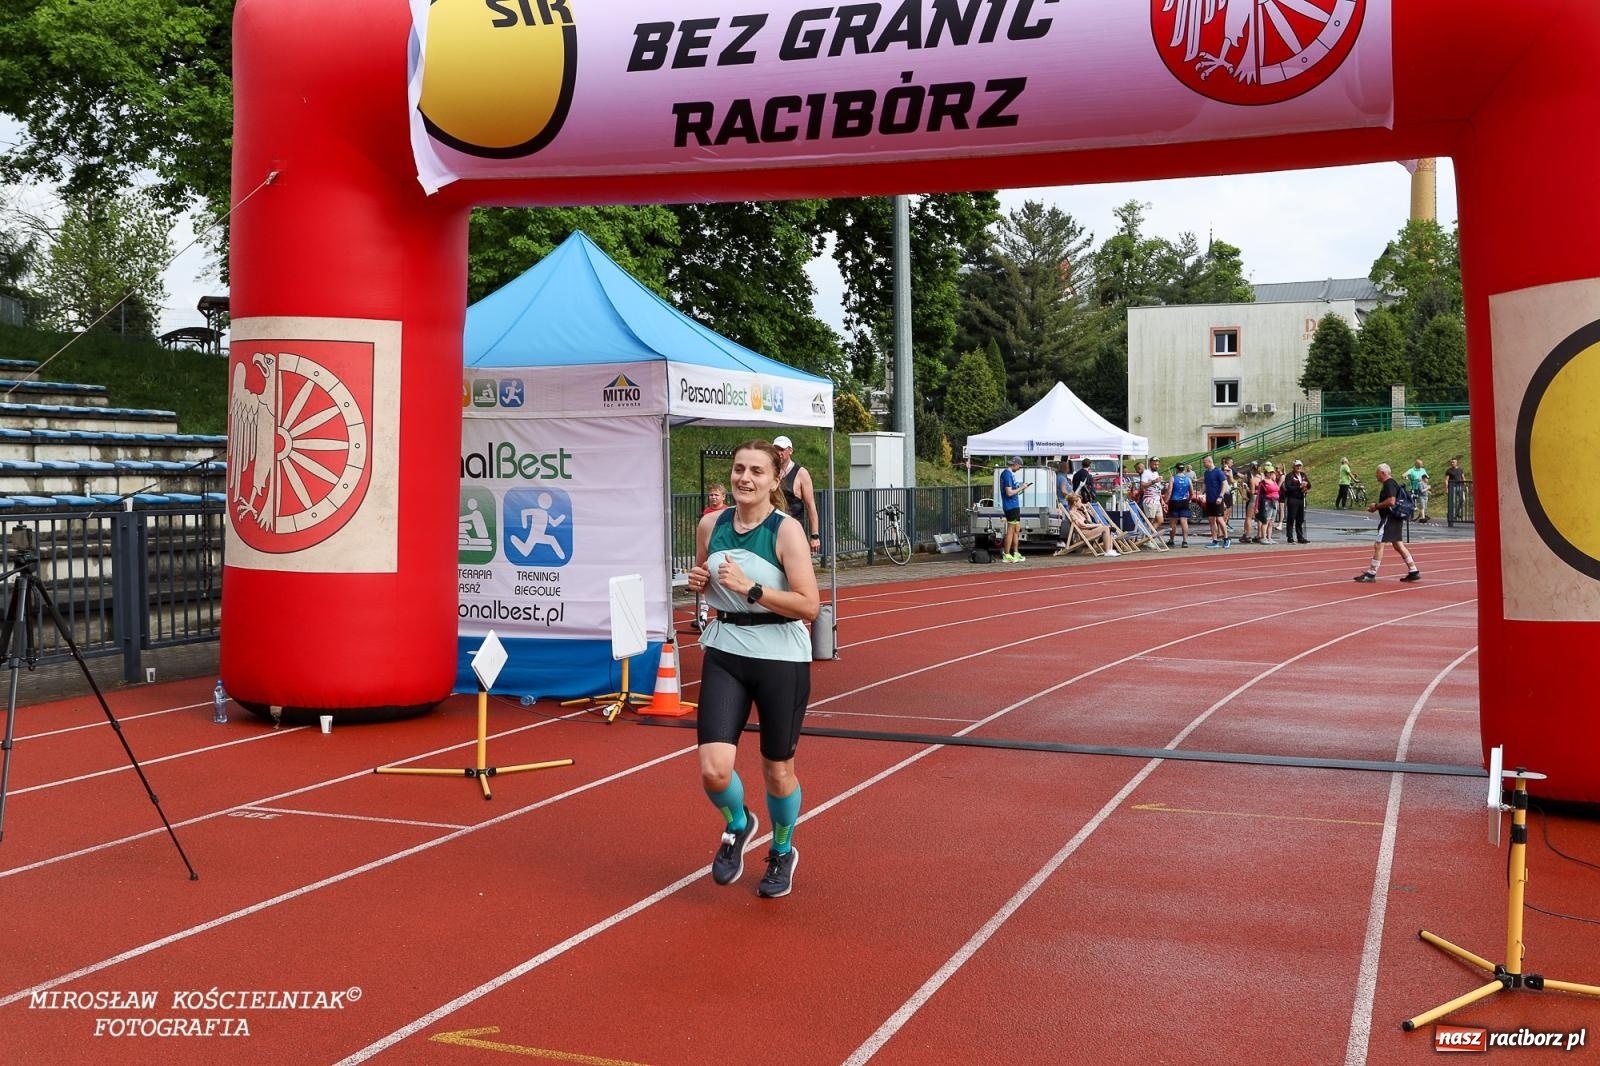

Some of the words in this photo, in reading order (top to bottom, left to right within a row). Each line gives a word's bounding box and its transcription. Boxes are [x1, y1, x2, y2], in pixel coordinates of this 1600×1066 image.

[626, 12, 768, 72] BEZ
[779, 0, 1062, 62] GRANIC
[672, 71, 1027, 148] RACIBÓRZ
[603, 388, 641, 402] MITKO
[681, 378, 748, 407] PersonalBest
[460, 442, 573, 480] alBest
[458, 569, 493, 580] TERAPIA
[516, 571, 560, 581] TRENINGI
[458, 582, 481, 594] ASAŻ
[514, 585, 561, 597] BIEGOWE
[458, 600, 565, 627] onalbest.pl
